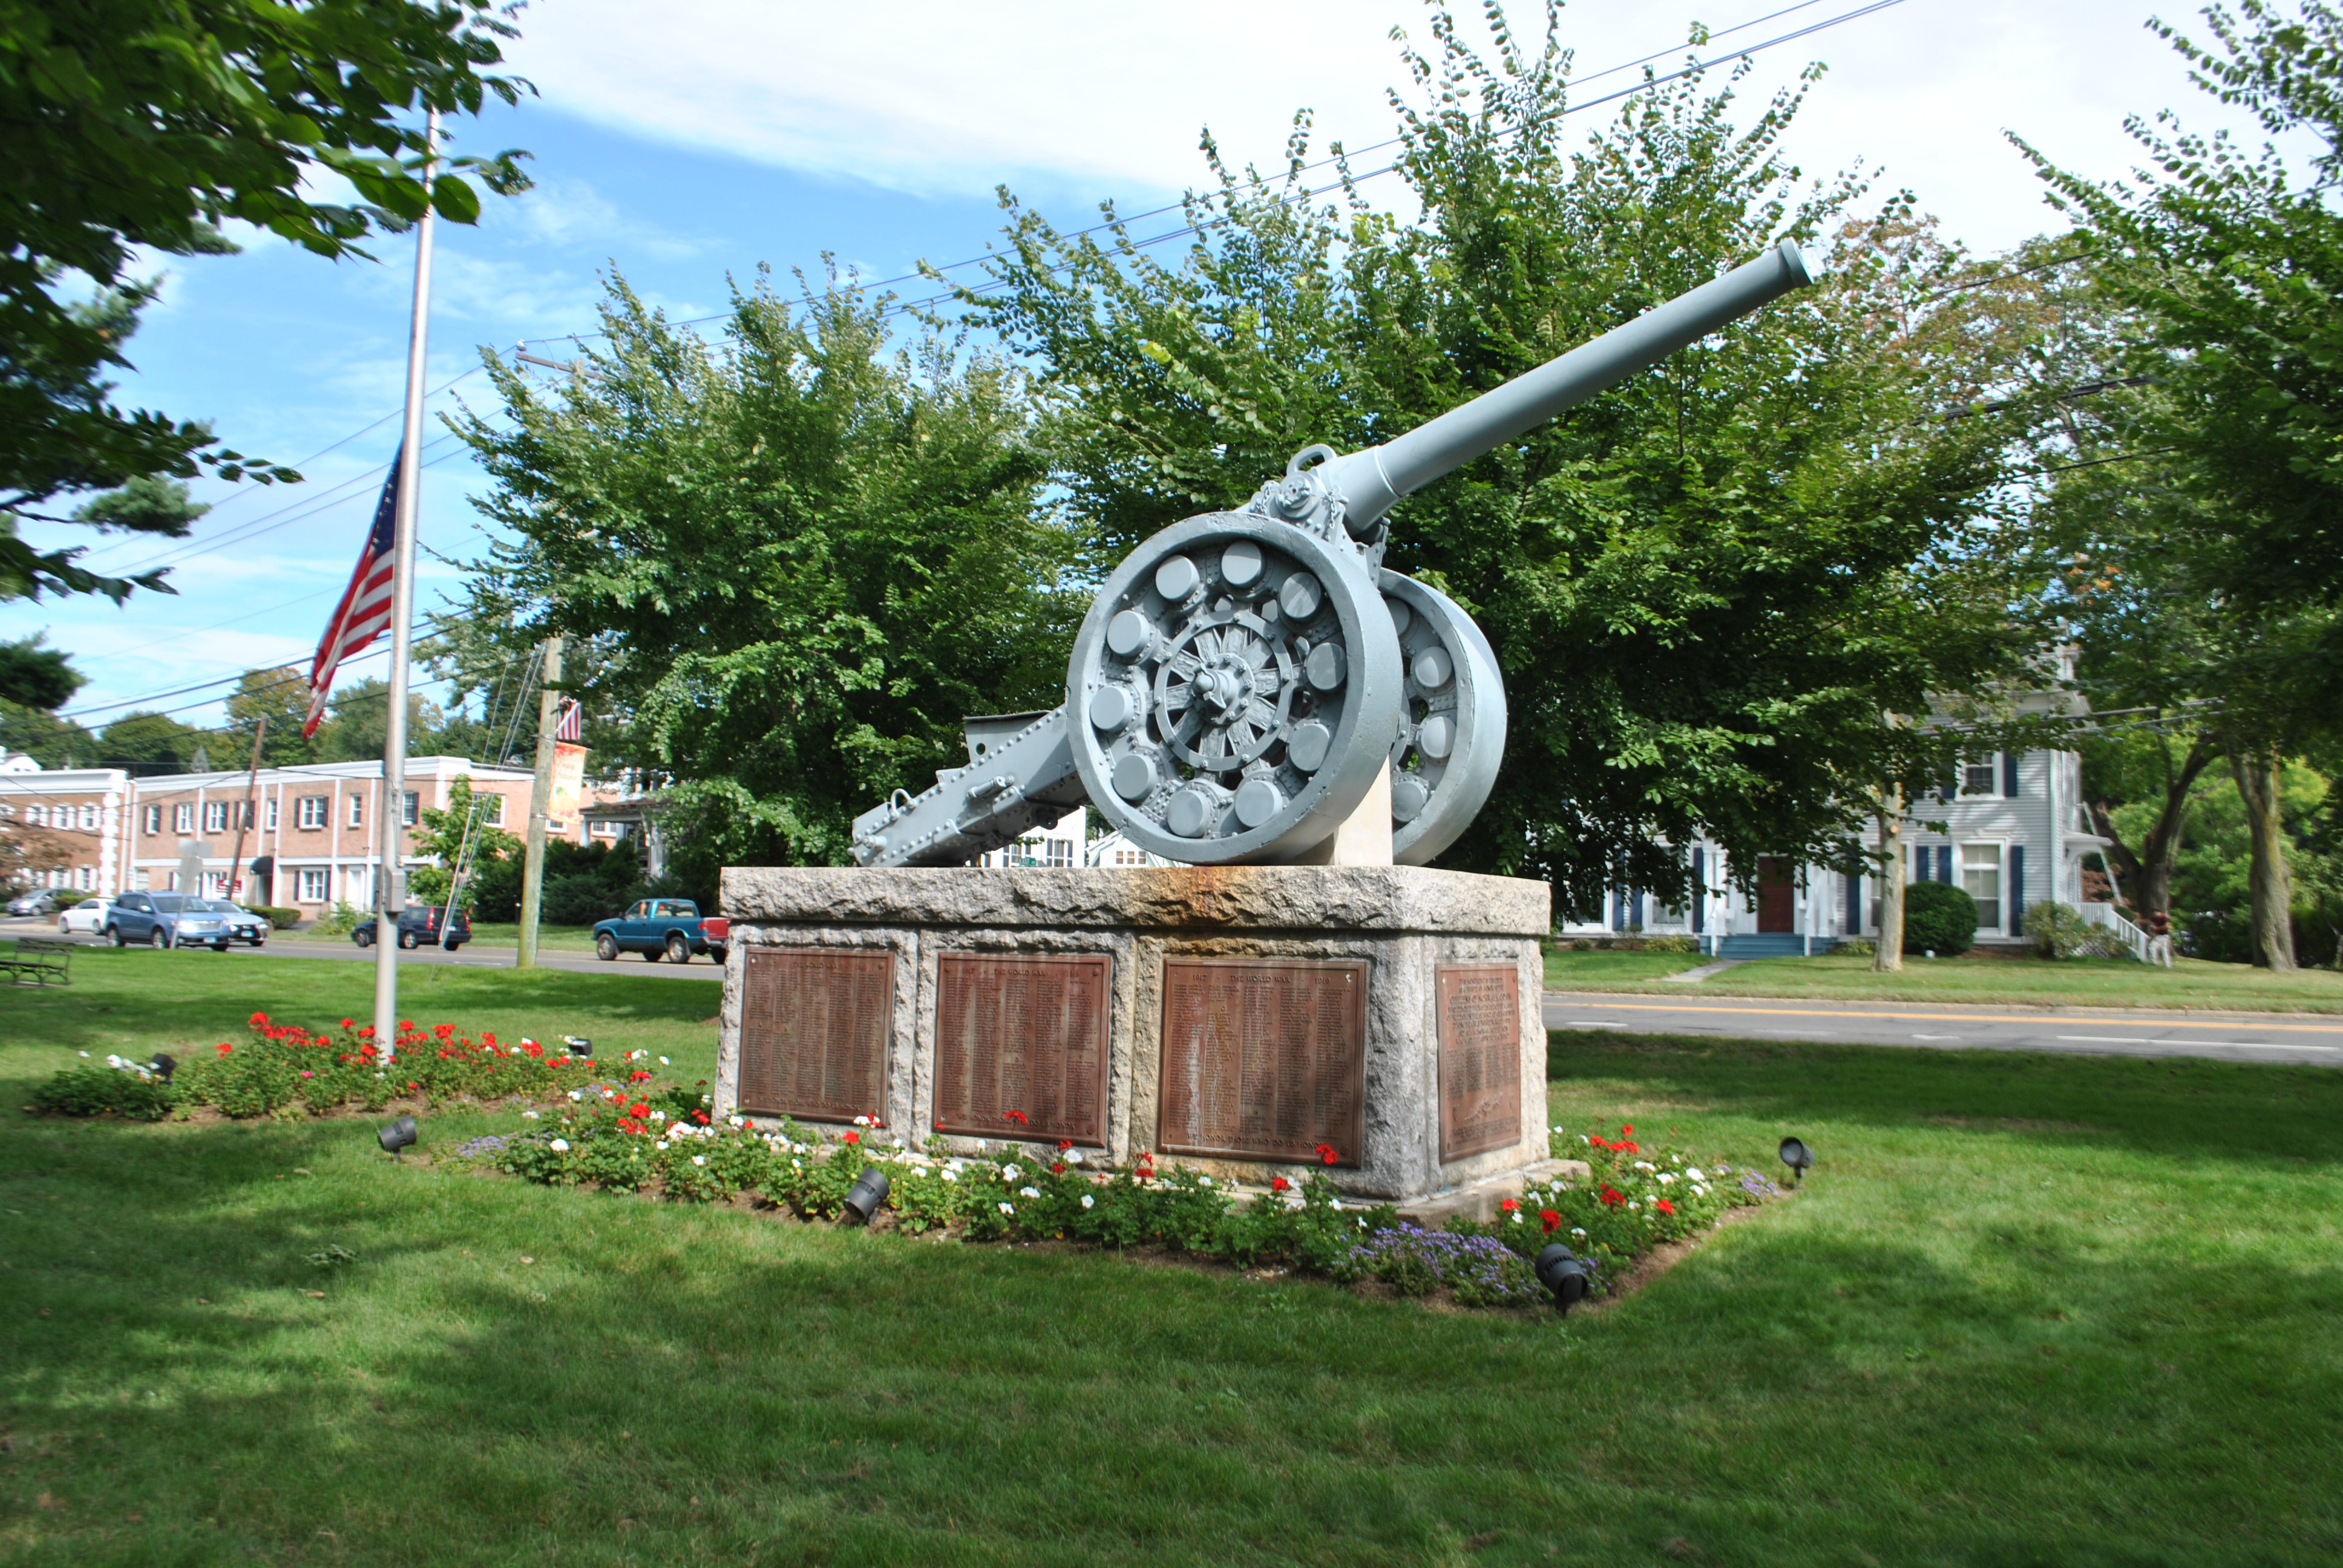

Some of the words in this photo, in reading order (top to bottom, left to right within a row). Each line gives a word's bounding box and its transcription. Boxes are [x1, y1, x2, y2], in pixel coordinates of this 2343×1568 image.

[1246, 975, 1271, 983] WORLD
[1201, 1133, 1226, 1143] HONOR
[1228, 1135, 1250, 1144] THOSE
[1252, 1137, 1270, 1146] WHO
[1273, 1138, 1283, 1147] DO
